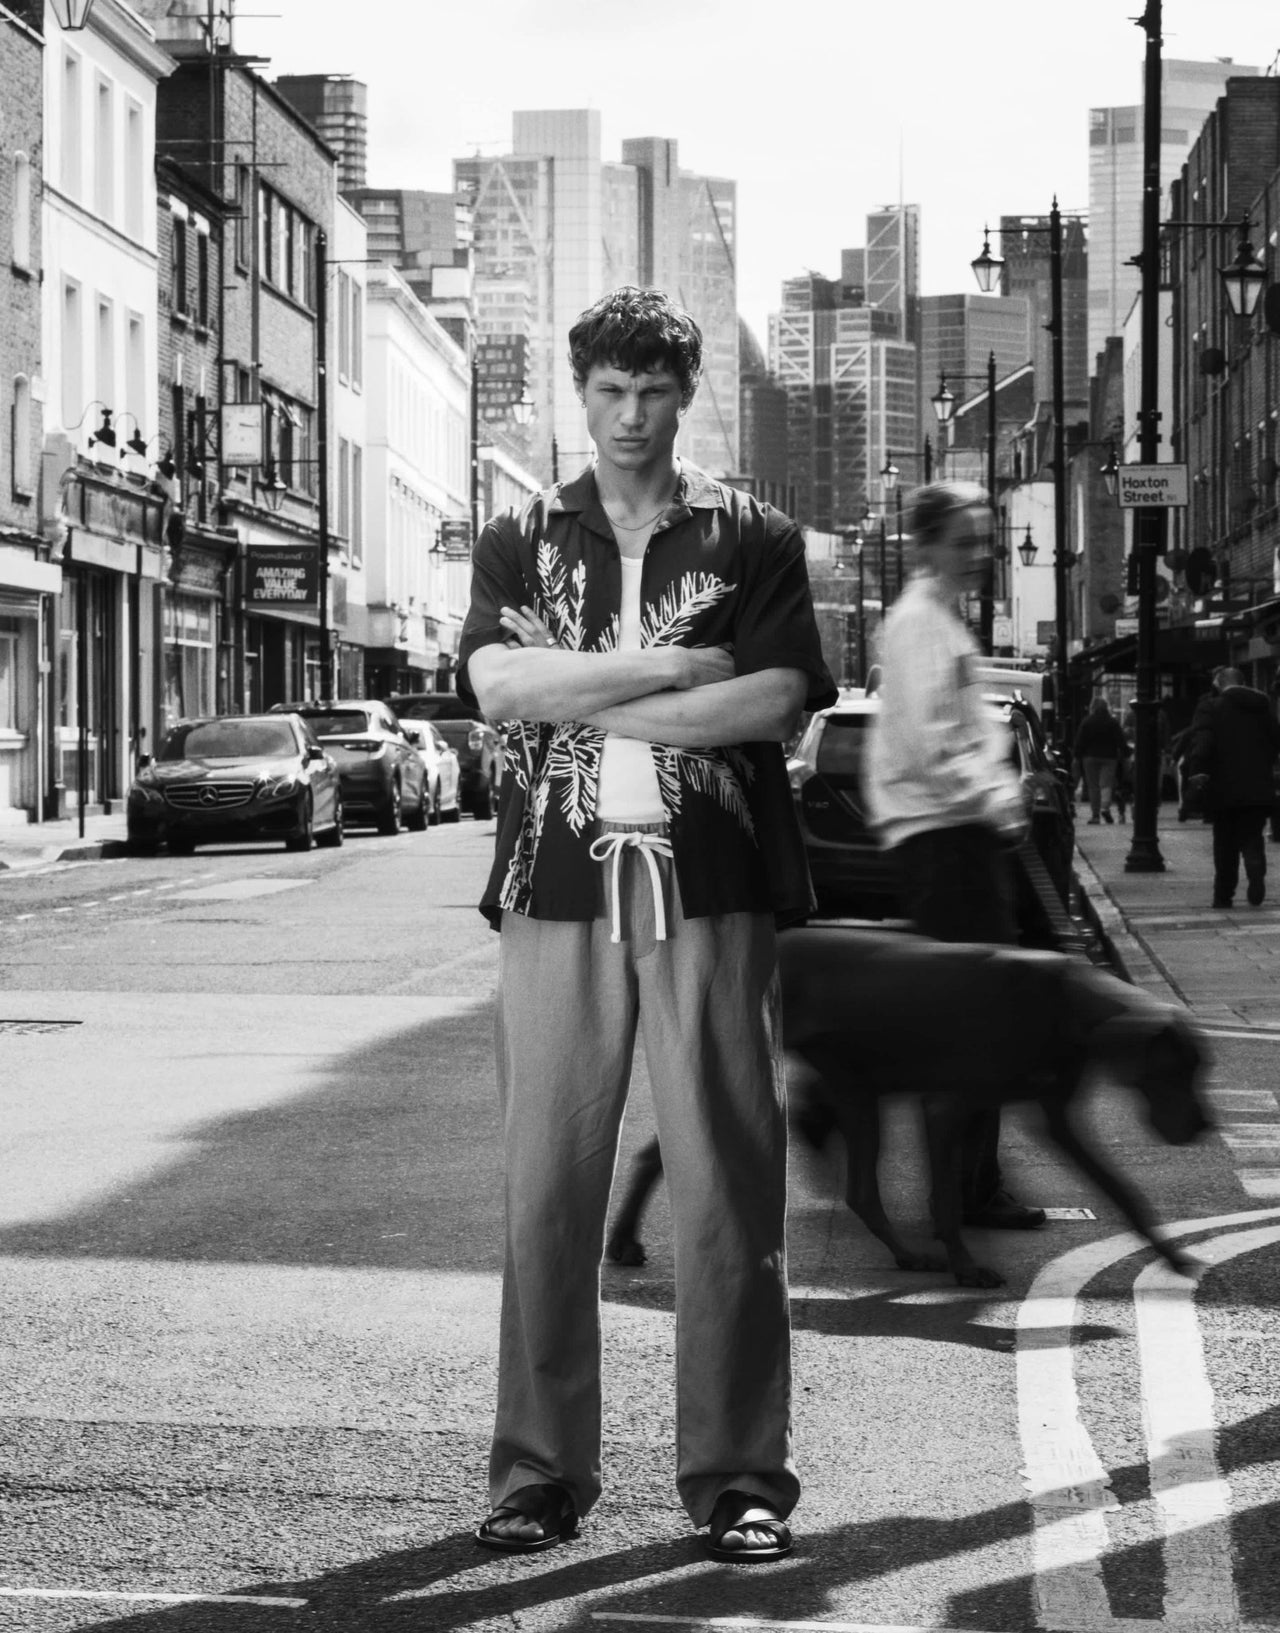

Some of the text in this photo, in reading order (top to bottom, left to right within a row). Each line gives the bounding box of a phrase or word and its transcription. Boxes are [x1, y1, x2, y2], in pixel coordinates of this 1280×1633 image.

[1122, 476, 1168, 489] Hoxton
[1123, 490, 1164, 503] Street
[256, 567, 306, 579] AMAZING
[264, 578, 298, 589] VALUE
[253, 588, 307, 600] EVERYDAY
